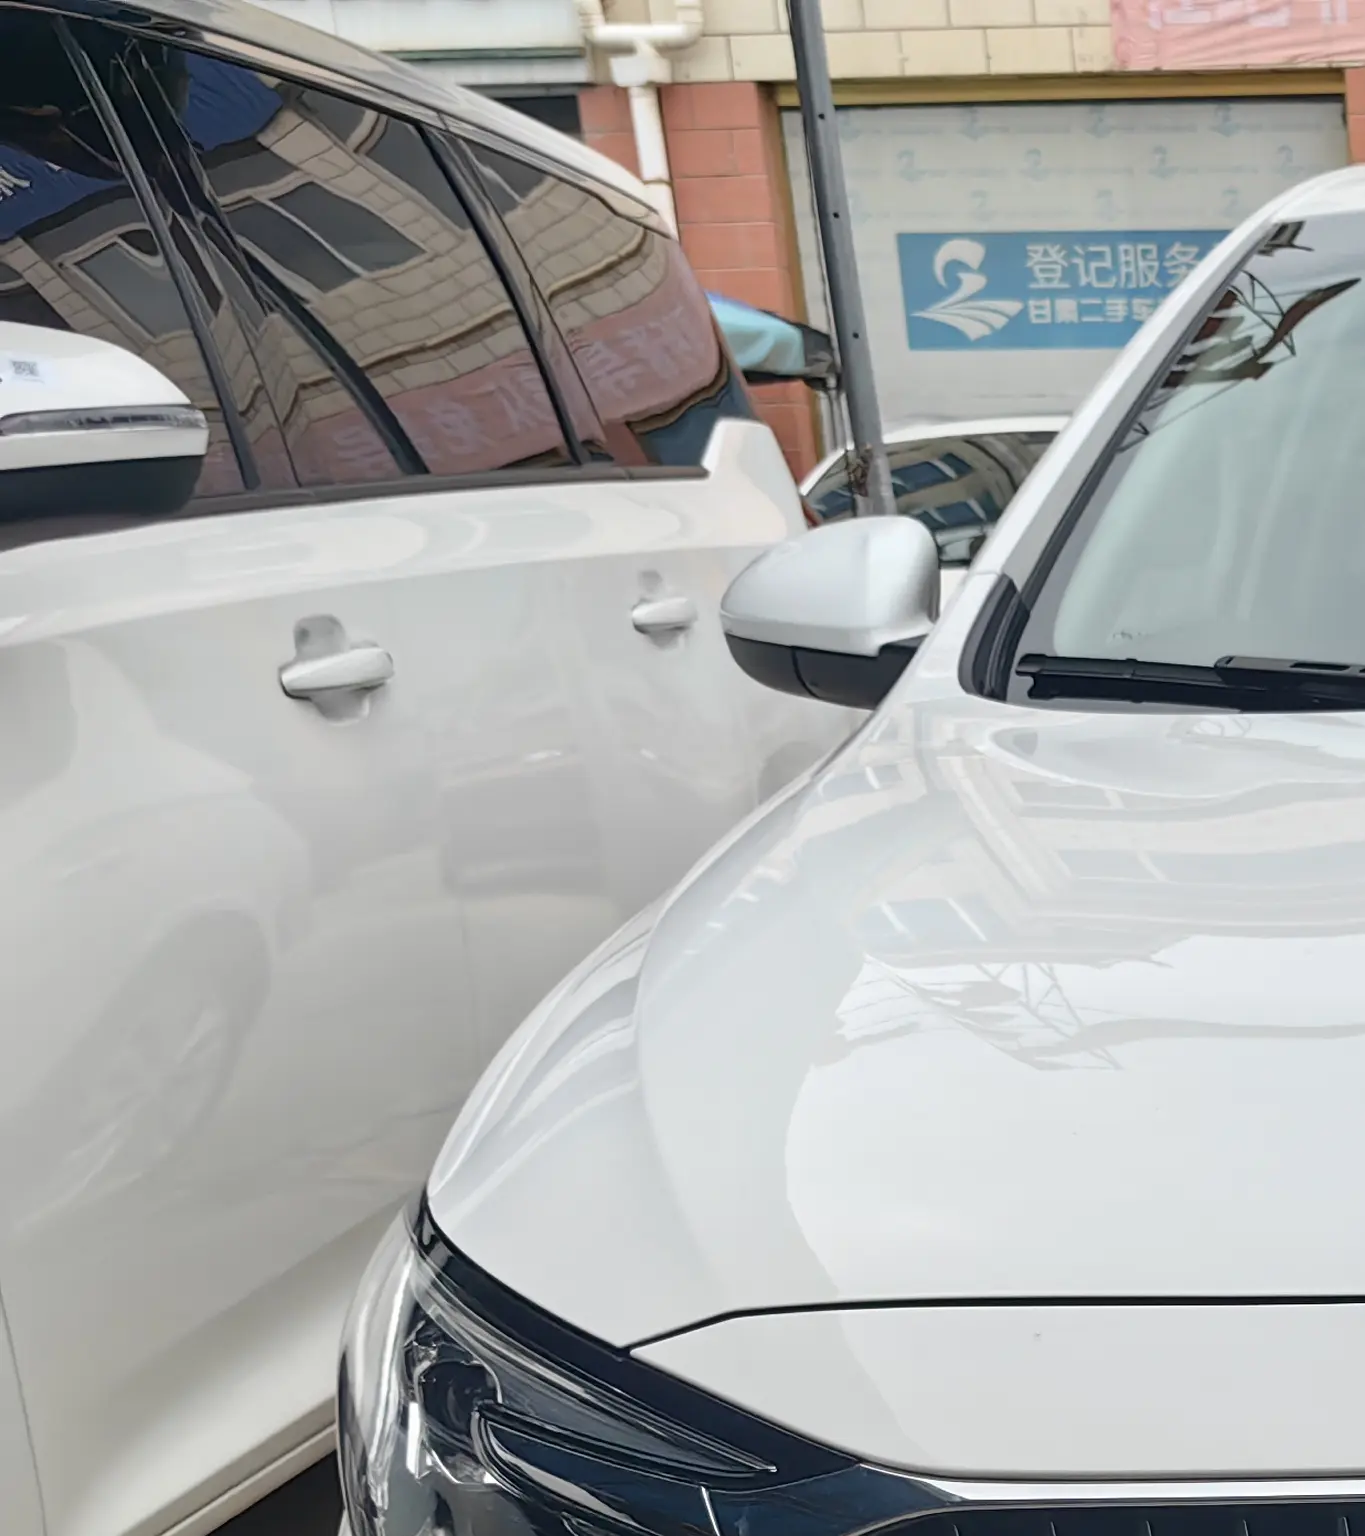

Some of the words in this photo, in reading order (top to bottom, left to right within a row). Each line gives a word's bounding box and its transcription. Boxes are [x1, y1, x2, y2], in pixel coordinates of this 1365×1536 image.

[1026, 242, 1221, 289] 登记服务
[1028, 297, 1163, 324] 甘肃二手车
